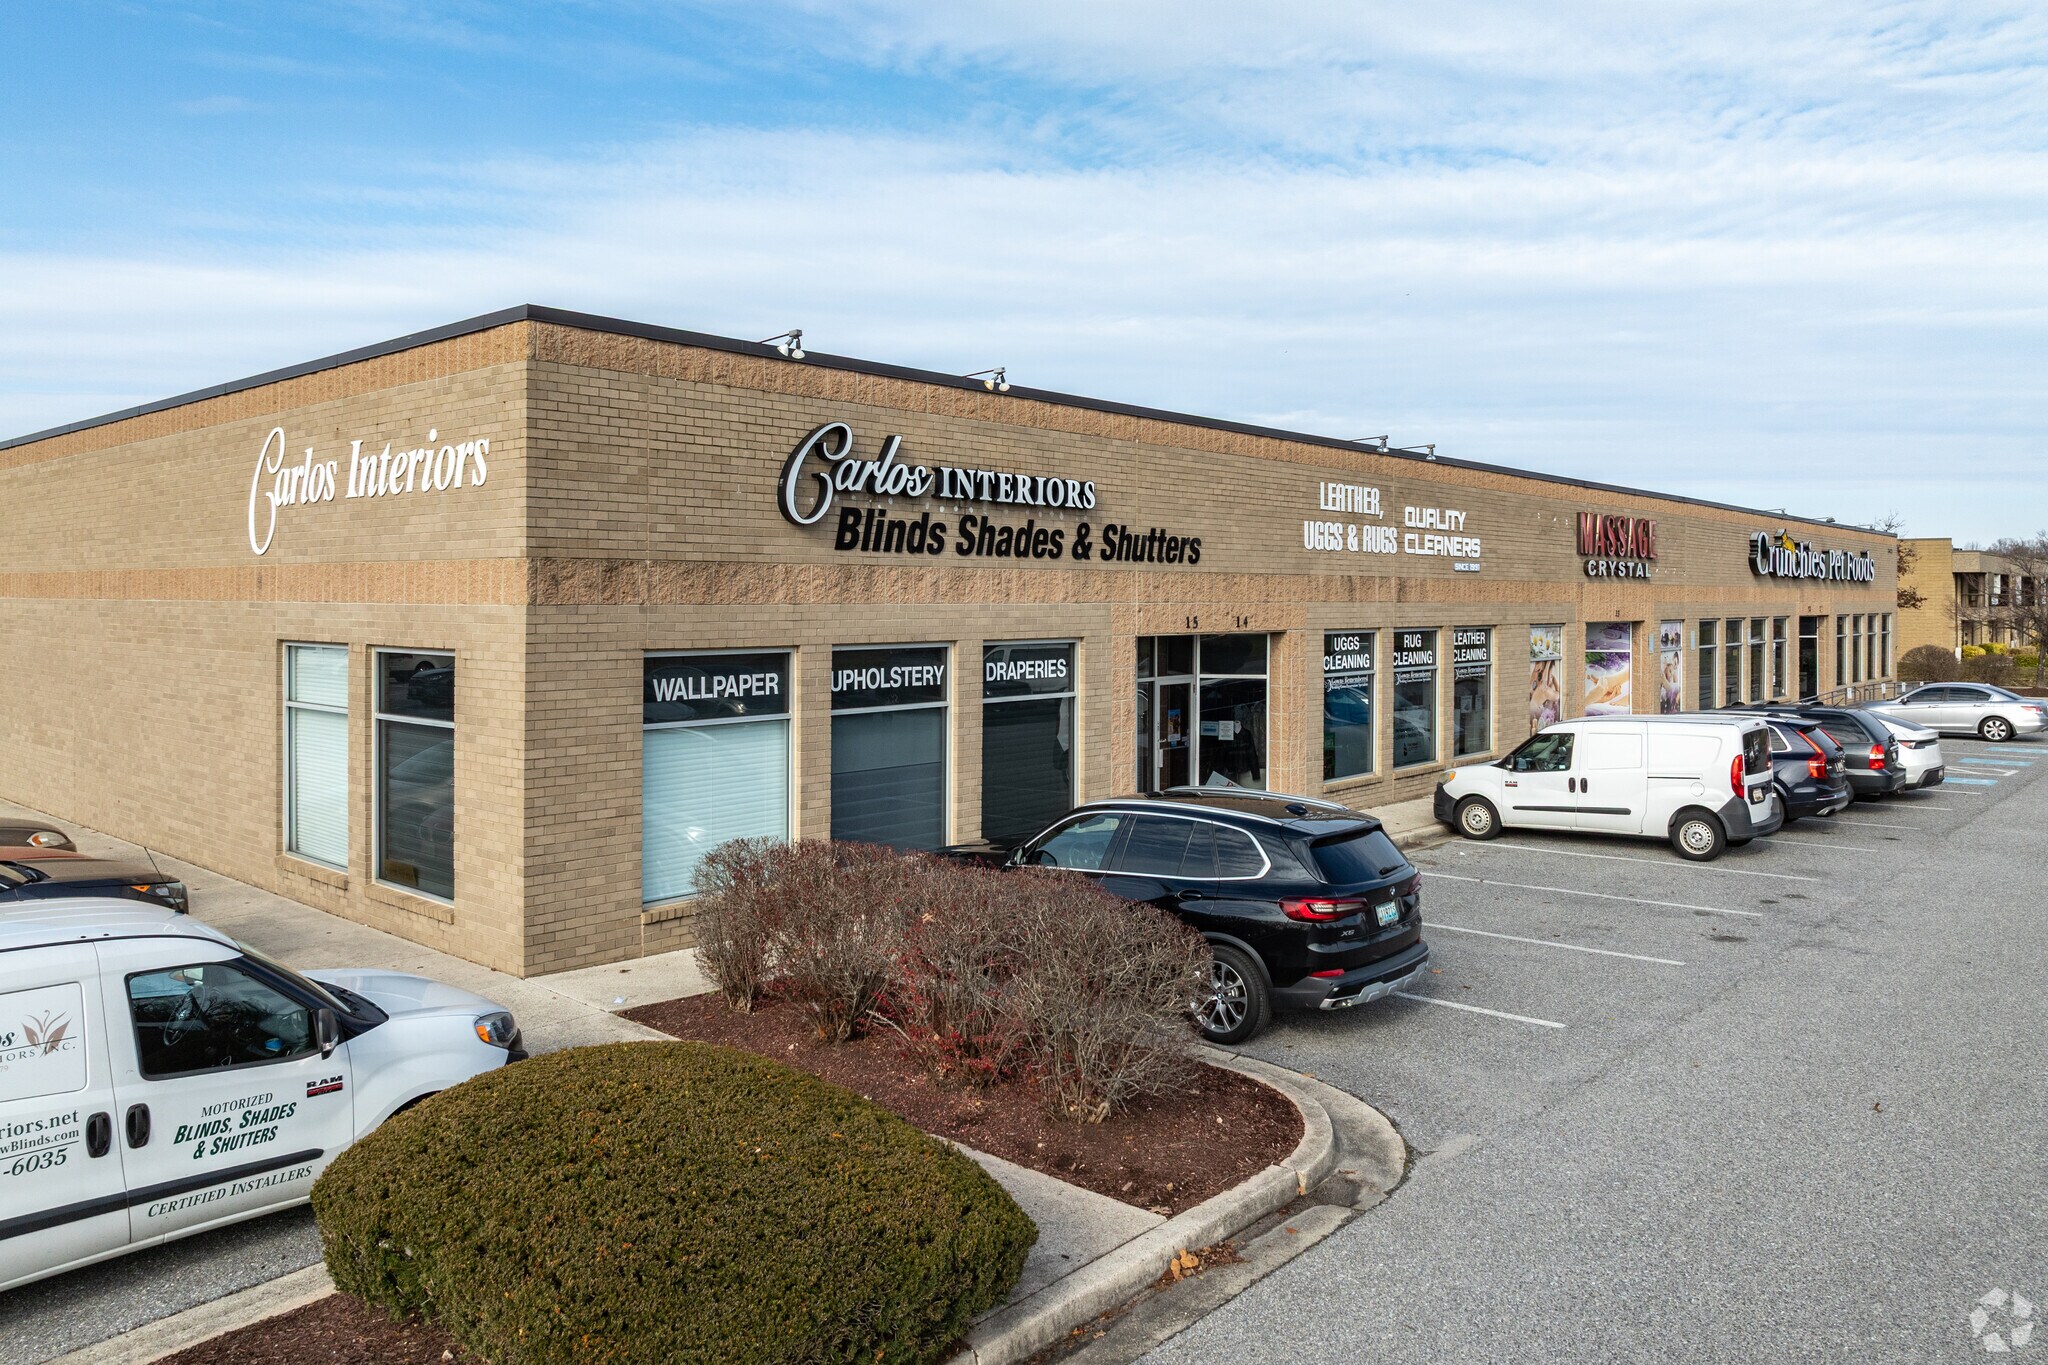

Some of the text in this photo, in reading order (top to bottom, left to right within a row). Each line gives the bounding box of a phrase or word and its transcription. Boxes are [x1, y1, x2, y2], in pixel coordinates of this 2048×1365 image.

[779, 421, 1097, 526] Carlos INTERIORS
[249, 427, 490, 555] Carlos Interiors
[1320, 481, 1384, 519] LEATHER,
[1405, 506, 1467, 531] QUALITY
[834, 506, 1202, 565] Blinds Shades & Shutters
[1304, 521, 1398, 554] UGGS & RUGS
[1405, 533, 1481, 558] CLEANERS
[1579, 512, 1657, 558] MASSAGE
[1588, 560, 1652, 578] CRYSTAL
[1756, 531, 1875, 581] Crunchies Pet Foods
[1185, 616, 1199, 629] 15
[1235, 616, 1249, 629] 14
[1334, 636, 1360, 651] UGGS
[1404, 634, 1422, 648] RUG
[1454, 632, 1486, 645] LEATHER
[1323, 653, 1370, 671] CLEANING
[1393, 650, 1433, 666] CLEANING
[1454, 648, 1487, 661] CLEANING
[831, 664, 944, 693] UPHOLSTERY
[985, 658, 1068, 682] DRAPERIES
[653, 672, 779, 702] WALLPAPER
[306, 1074, 343, 1089] RAM
[201, 1092, 274, 1118] MOTORIZED
[173, 1101, 298, 1145] BLINDS, SHADES
[193, 1125, 279, 1160] & SHUTTERS
[3, 1147, 68, 1176] -6035
[148, 1165, 313, 1218] CERTIFIED INSTALLERS
